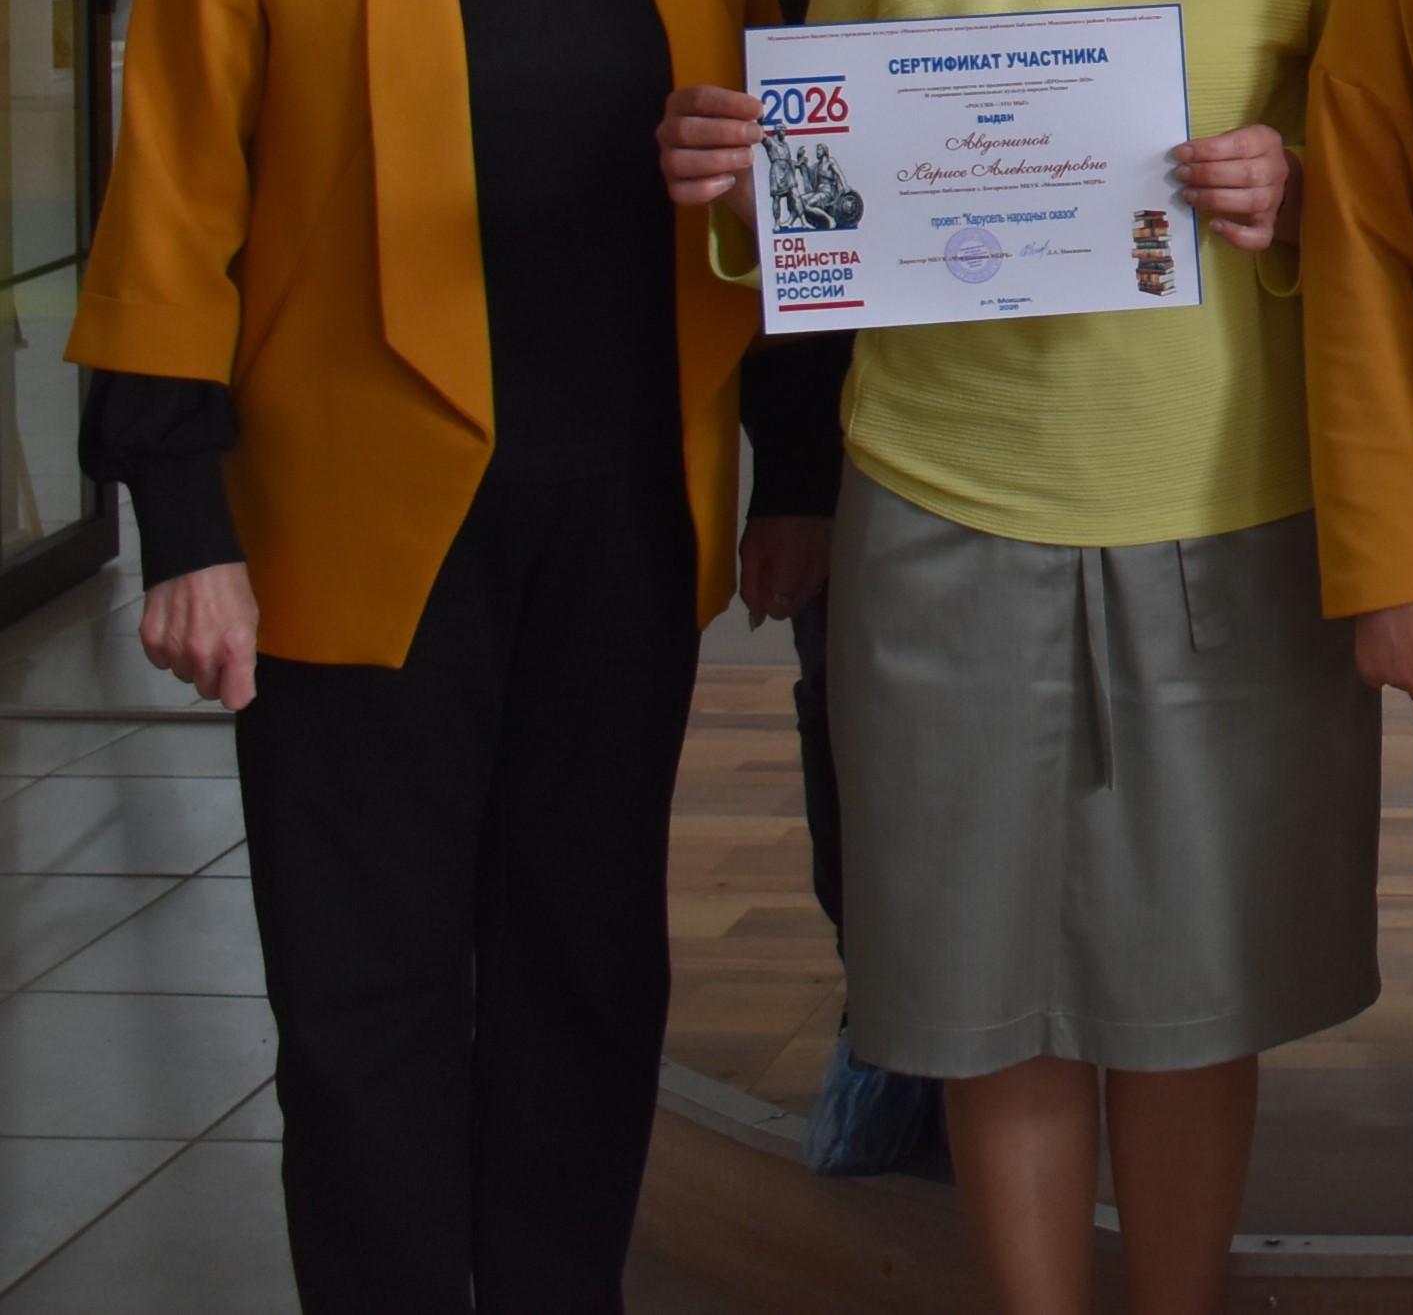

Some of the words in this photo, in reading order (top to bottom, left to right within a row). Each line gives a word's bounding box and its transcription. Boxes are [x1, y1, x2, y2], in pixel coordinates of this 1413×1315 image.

[887, 52, 1001, 75] СЕРТИФИКАТ
[1005, 46, 1108, 68] УЧАСТНИКА
[760, 85, 848, 127] 2026
[976, 113, 1014, 124] выдан
[944, 131, 1052, 156] Авдониной
[895, 161, 967, 185] Ларисе
[970, 154, 1107, 179] Александровне
[930, 215, 961, 229] проект:
[961, 212, 1005, 226] "Карусель
[1005, 211, 1047, 224] народных
[1048, 206, 1078, 220] сказок"
[772, 236, 806, 253] ГОД
[774, 250, 861, 270] ЕДИНСТВА
[775, 267, 853, 285] НАРОДОВ
[776, 283, 844, 300] РОССИИ
